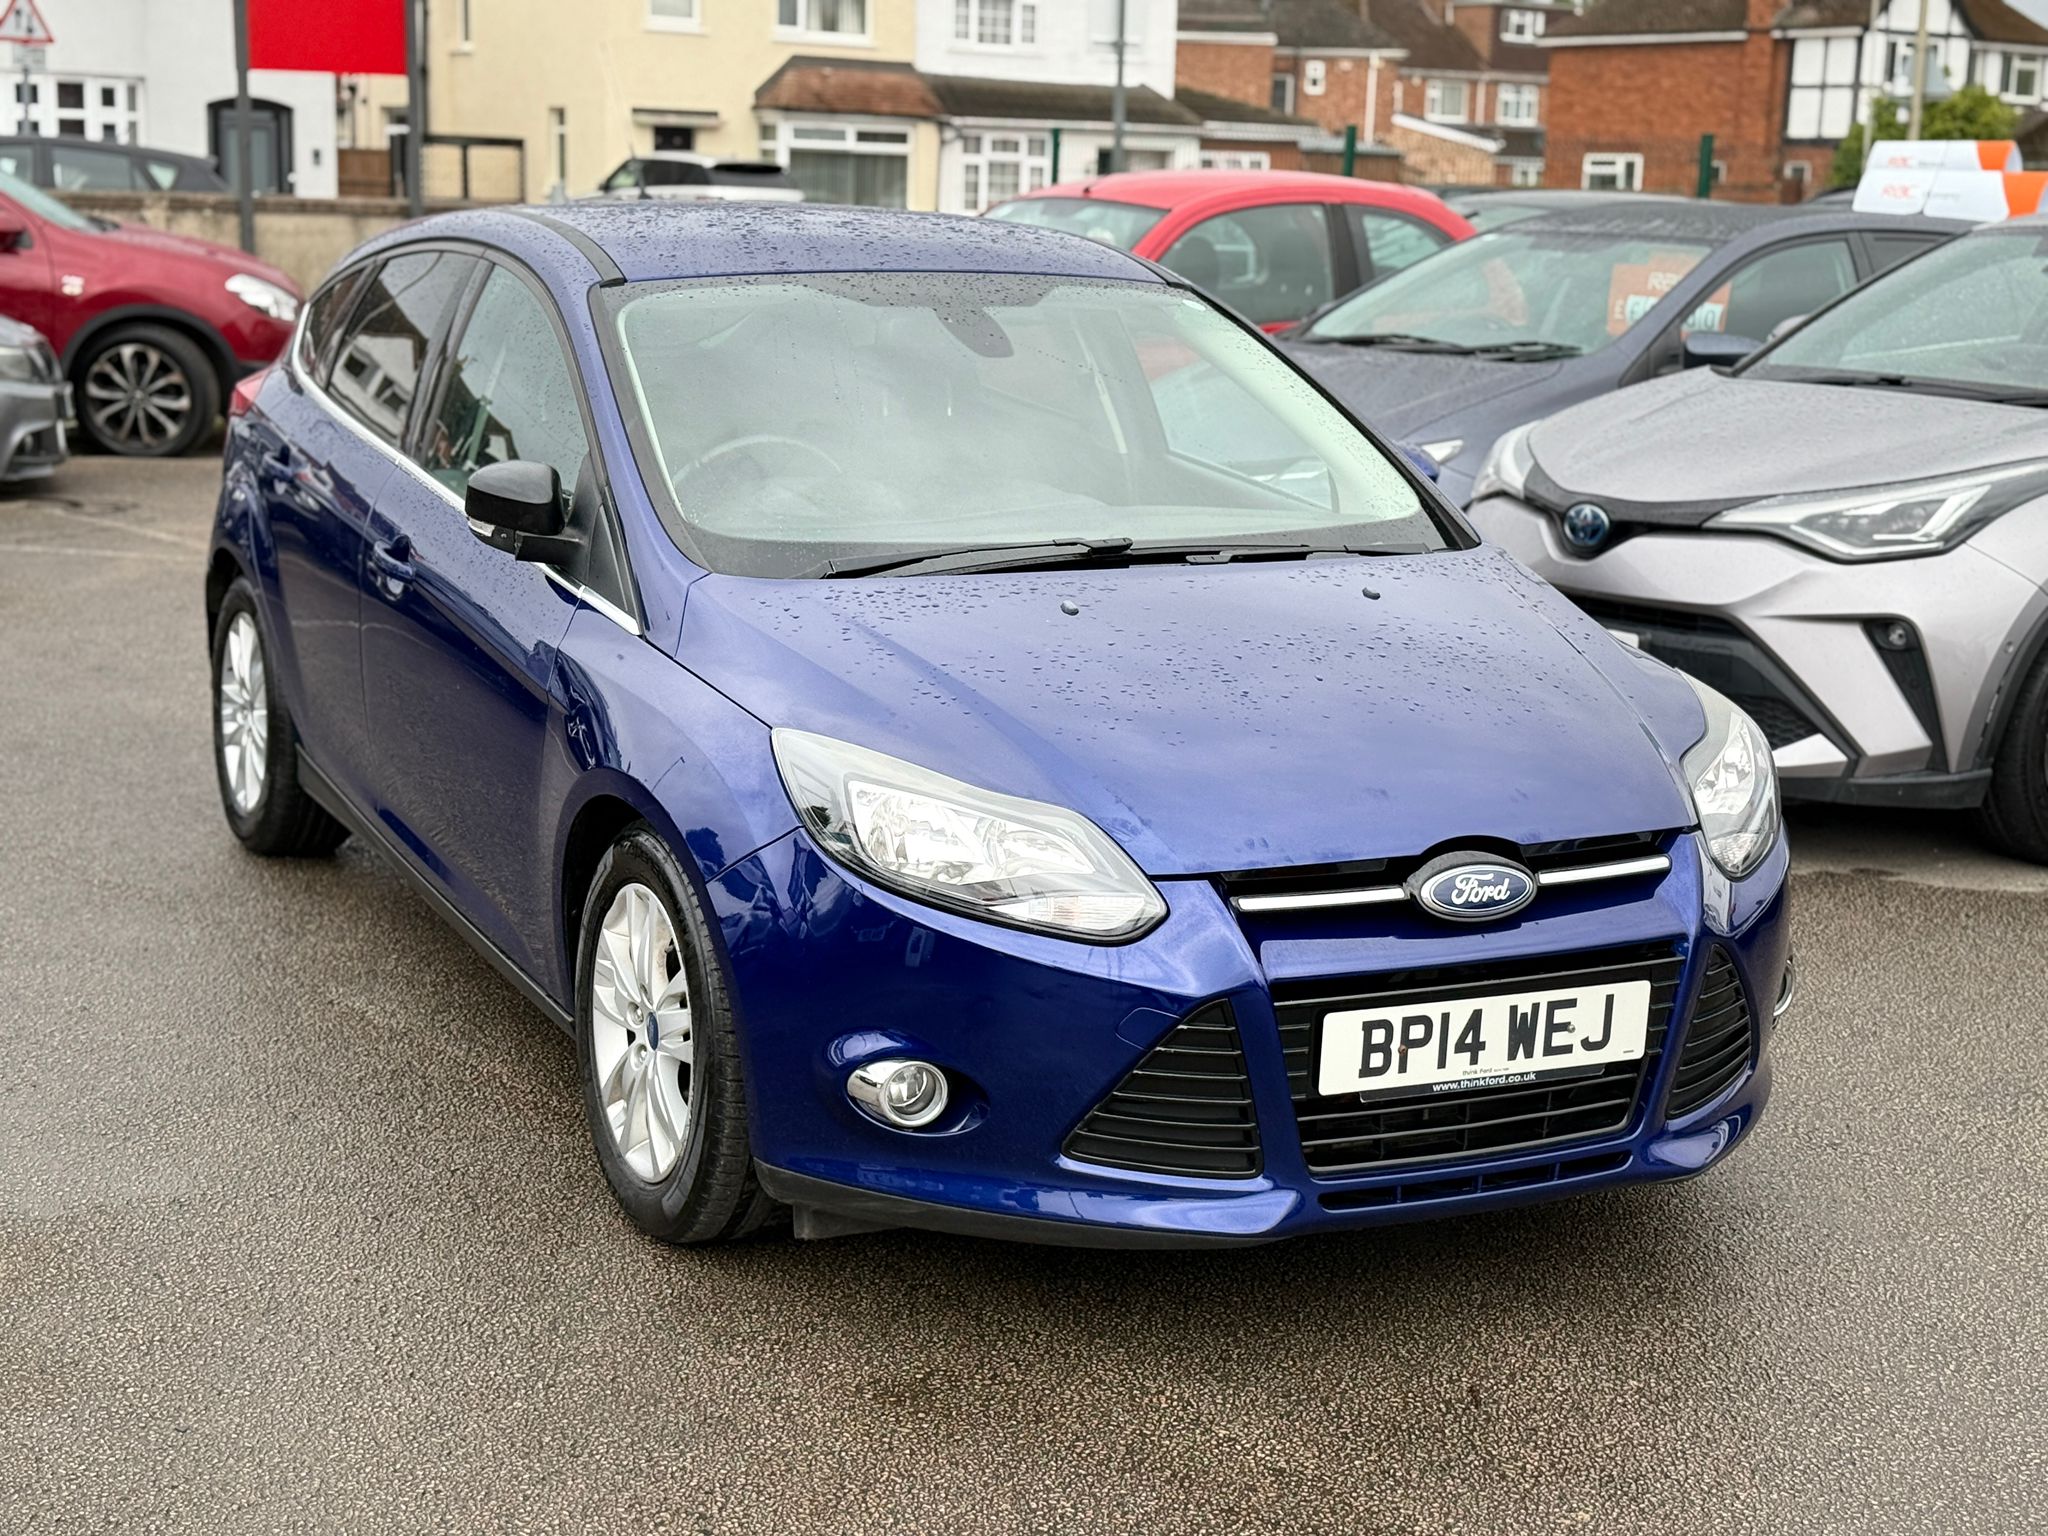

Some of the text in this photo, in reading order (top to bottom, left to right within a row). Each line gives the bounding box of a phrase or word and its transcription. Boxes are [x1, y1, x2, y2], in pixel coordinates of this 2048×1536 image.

[1451, 873, 1511, 905] Ford
[1358, 993, 1615, 1079] BP14 WEJ
[1432, 1072, 1537, 1092] www.thinkford.co.uk
